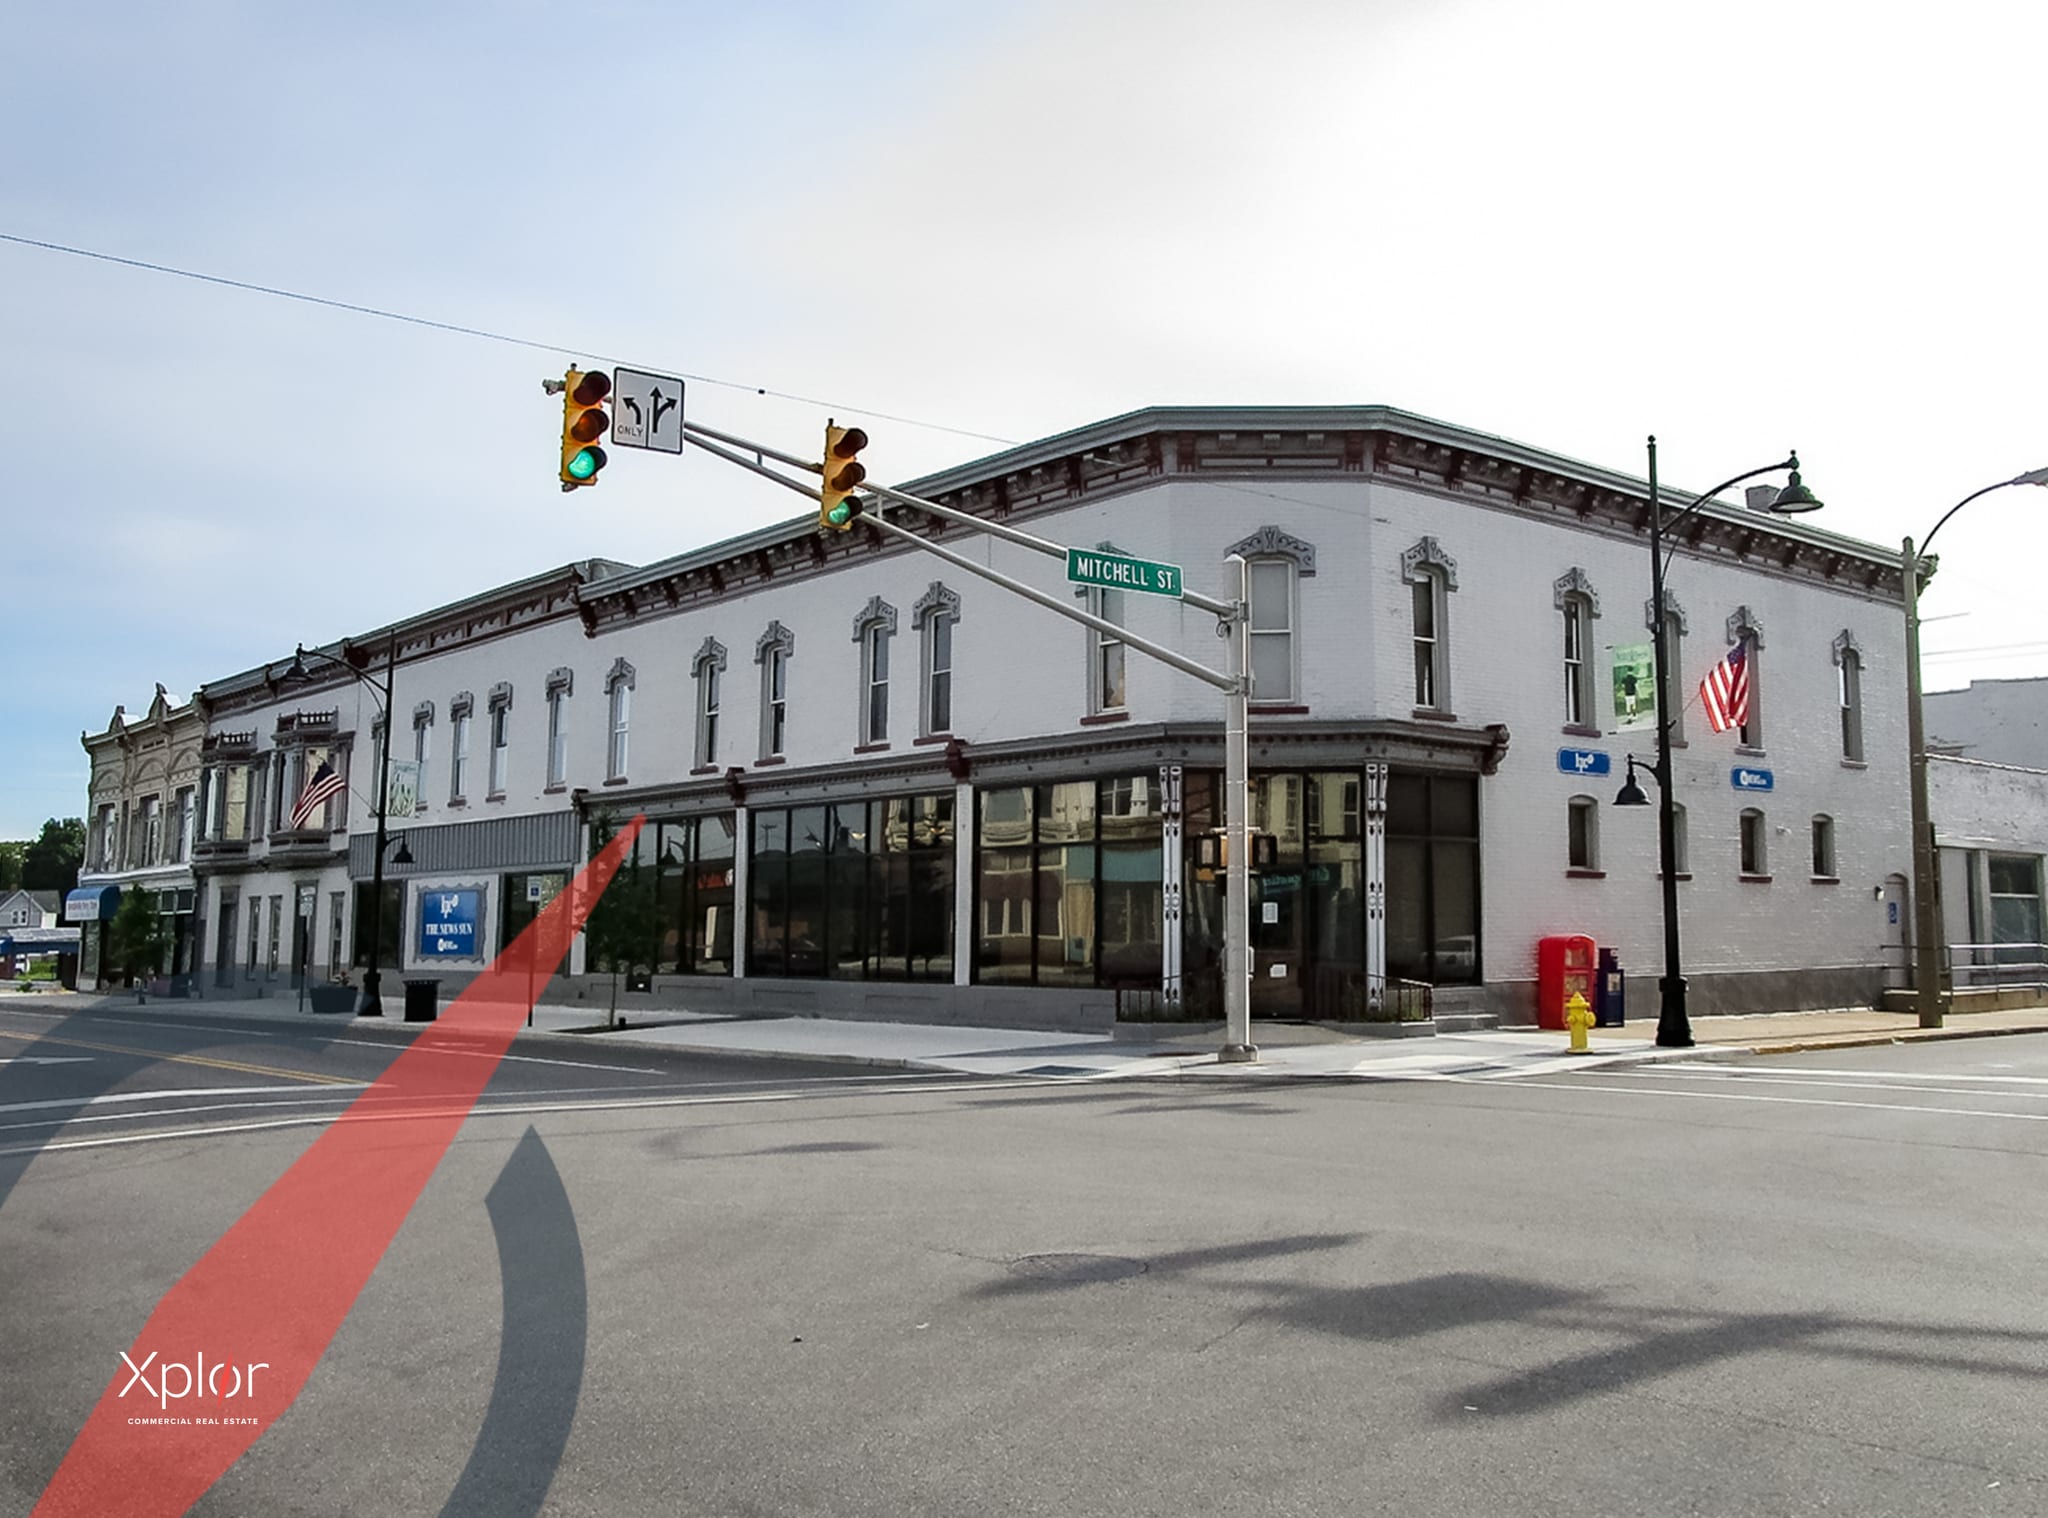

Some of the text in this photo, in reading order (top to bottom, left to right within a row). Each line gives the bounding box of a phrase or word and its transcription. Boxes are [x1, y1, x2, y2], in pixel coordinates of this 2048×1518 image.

[617, 425, 643, 437] ONLY
[1077, 556, 1148, 586] MITCHELL
[426, 923, 473, 935] THE NEWS SUN
